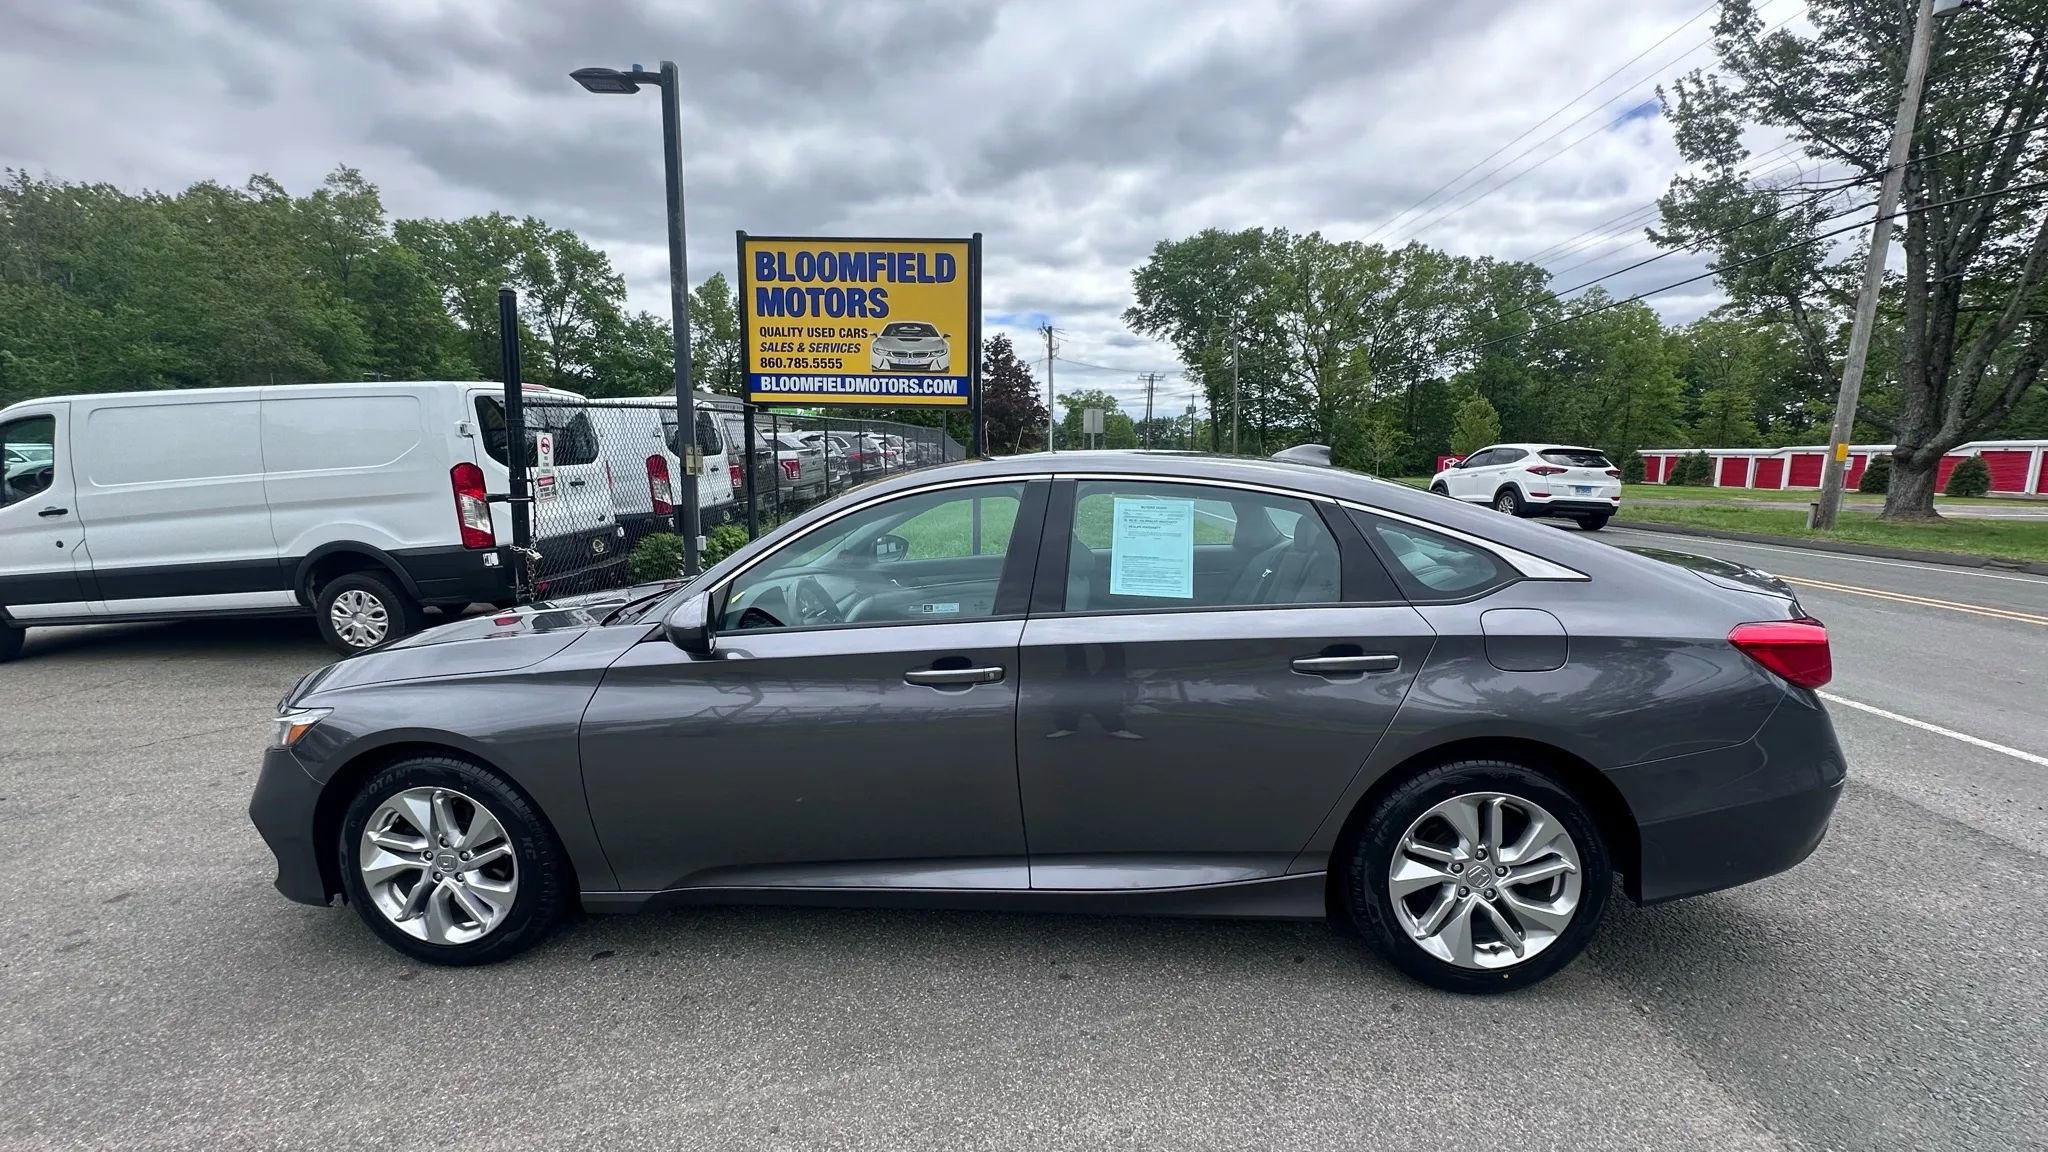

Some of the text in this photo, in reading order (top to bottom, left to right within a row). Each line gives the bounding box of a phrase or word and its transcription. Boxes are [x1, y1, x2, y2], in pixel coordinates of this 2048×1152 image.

[755, 251, 957, 283] BLOOMFIELD
[755, 287, 890, 318] MOTORS
[759, 326, 868, 339] QUALITY USED CARS
[759, 342, 861, 354] SALES & SERVICES
[760, 357, 843, 369] 860.785.5555
[760, 376, 958, 394] BLOOMFIELDMOTORS.COM
